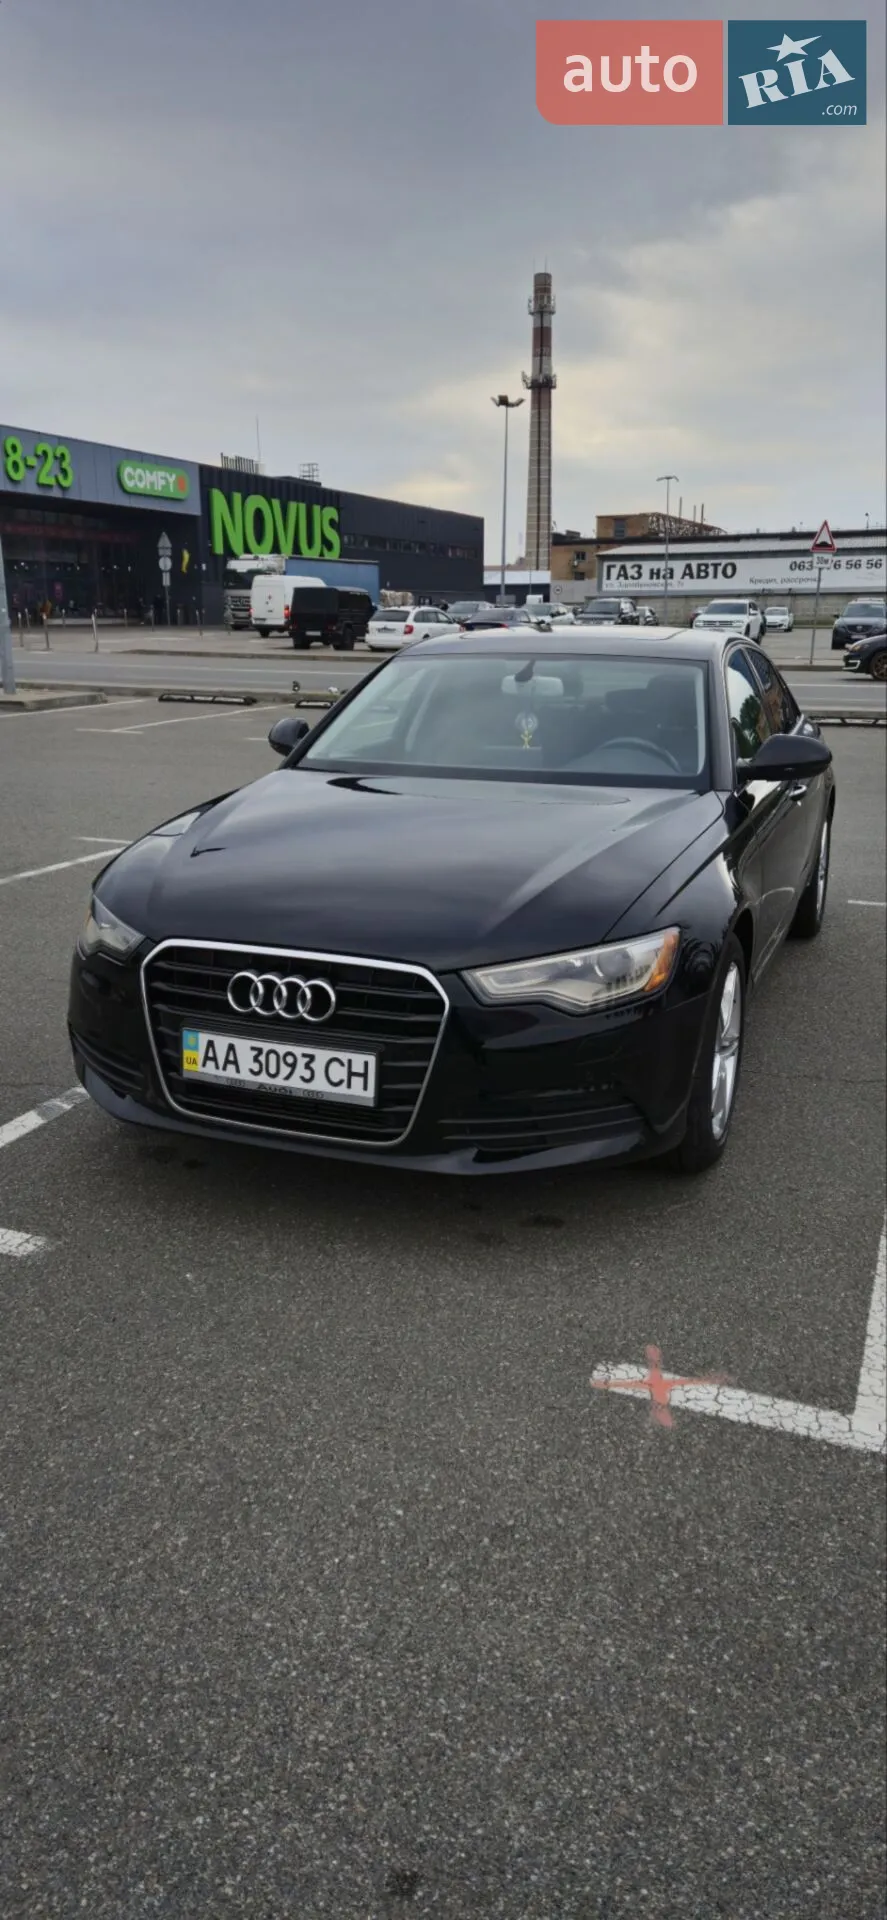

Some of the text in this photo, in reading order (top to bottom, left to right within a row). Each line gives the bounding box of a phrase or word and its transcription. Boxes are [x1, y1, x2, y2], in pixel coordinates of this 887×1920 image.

[4, 435, 73, 488] 8-23
[123, 466, 176, 493] COMFY
[210, 488, 341, 559] NOVUS
[606, 562, 737, 581] ГАЗ на АВТО
[789, 560, 814, 572] 063
[846, 559, 862, 570] 56
[867, 558, 883, 570] 56
[186, 1056, 198, 1067] UA
[202, 1039, 369, 1092] AA 3093 CH
